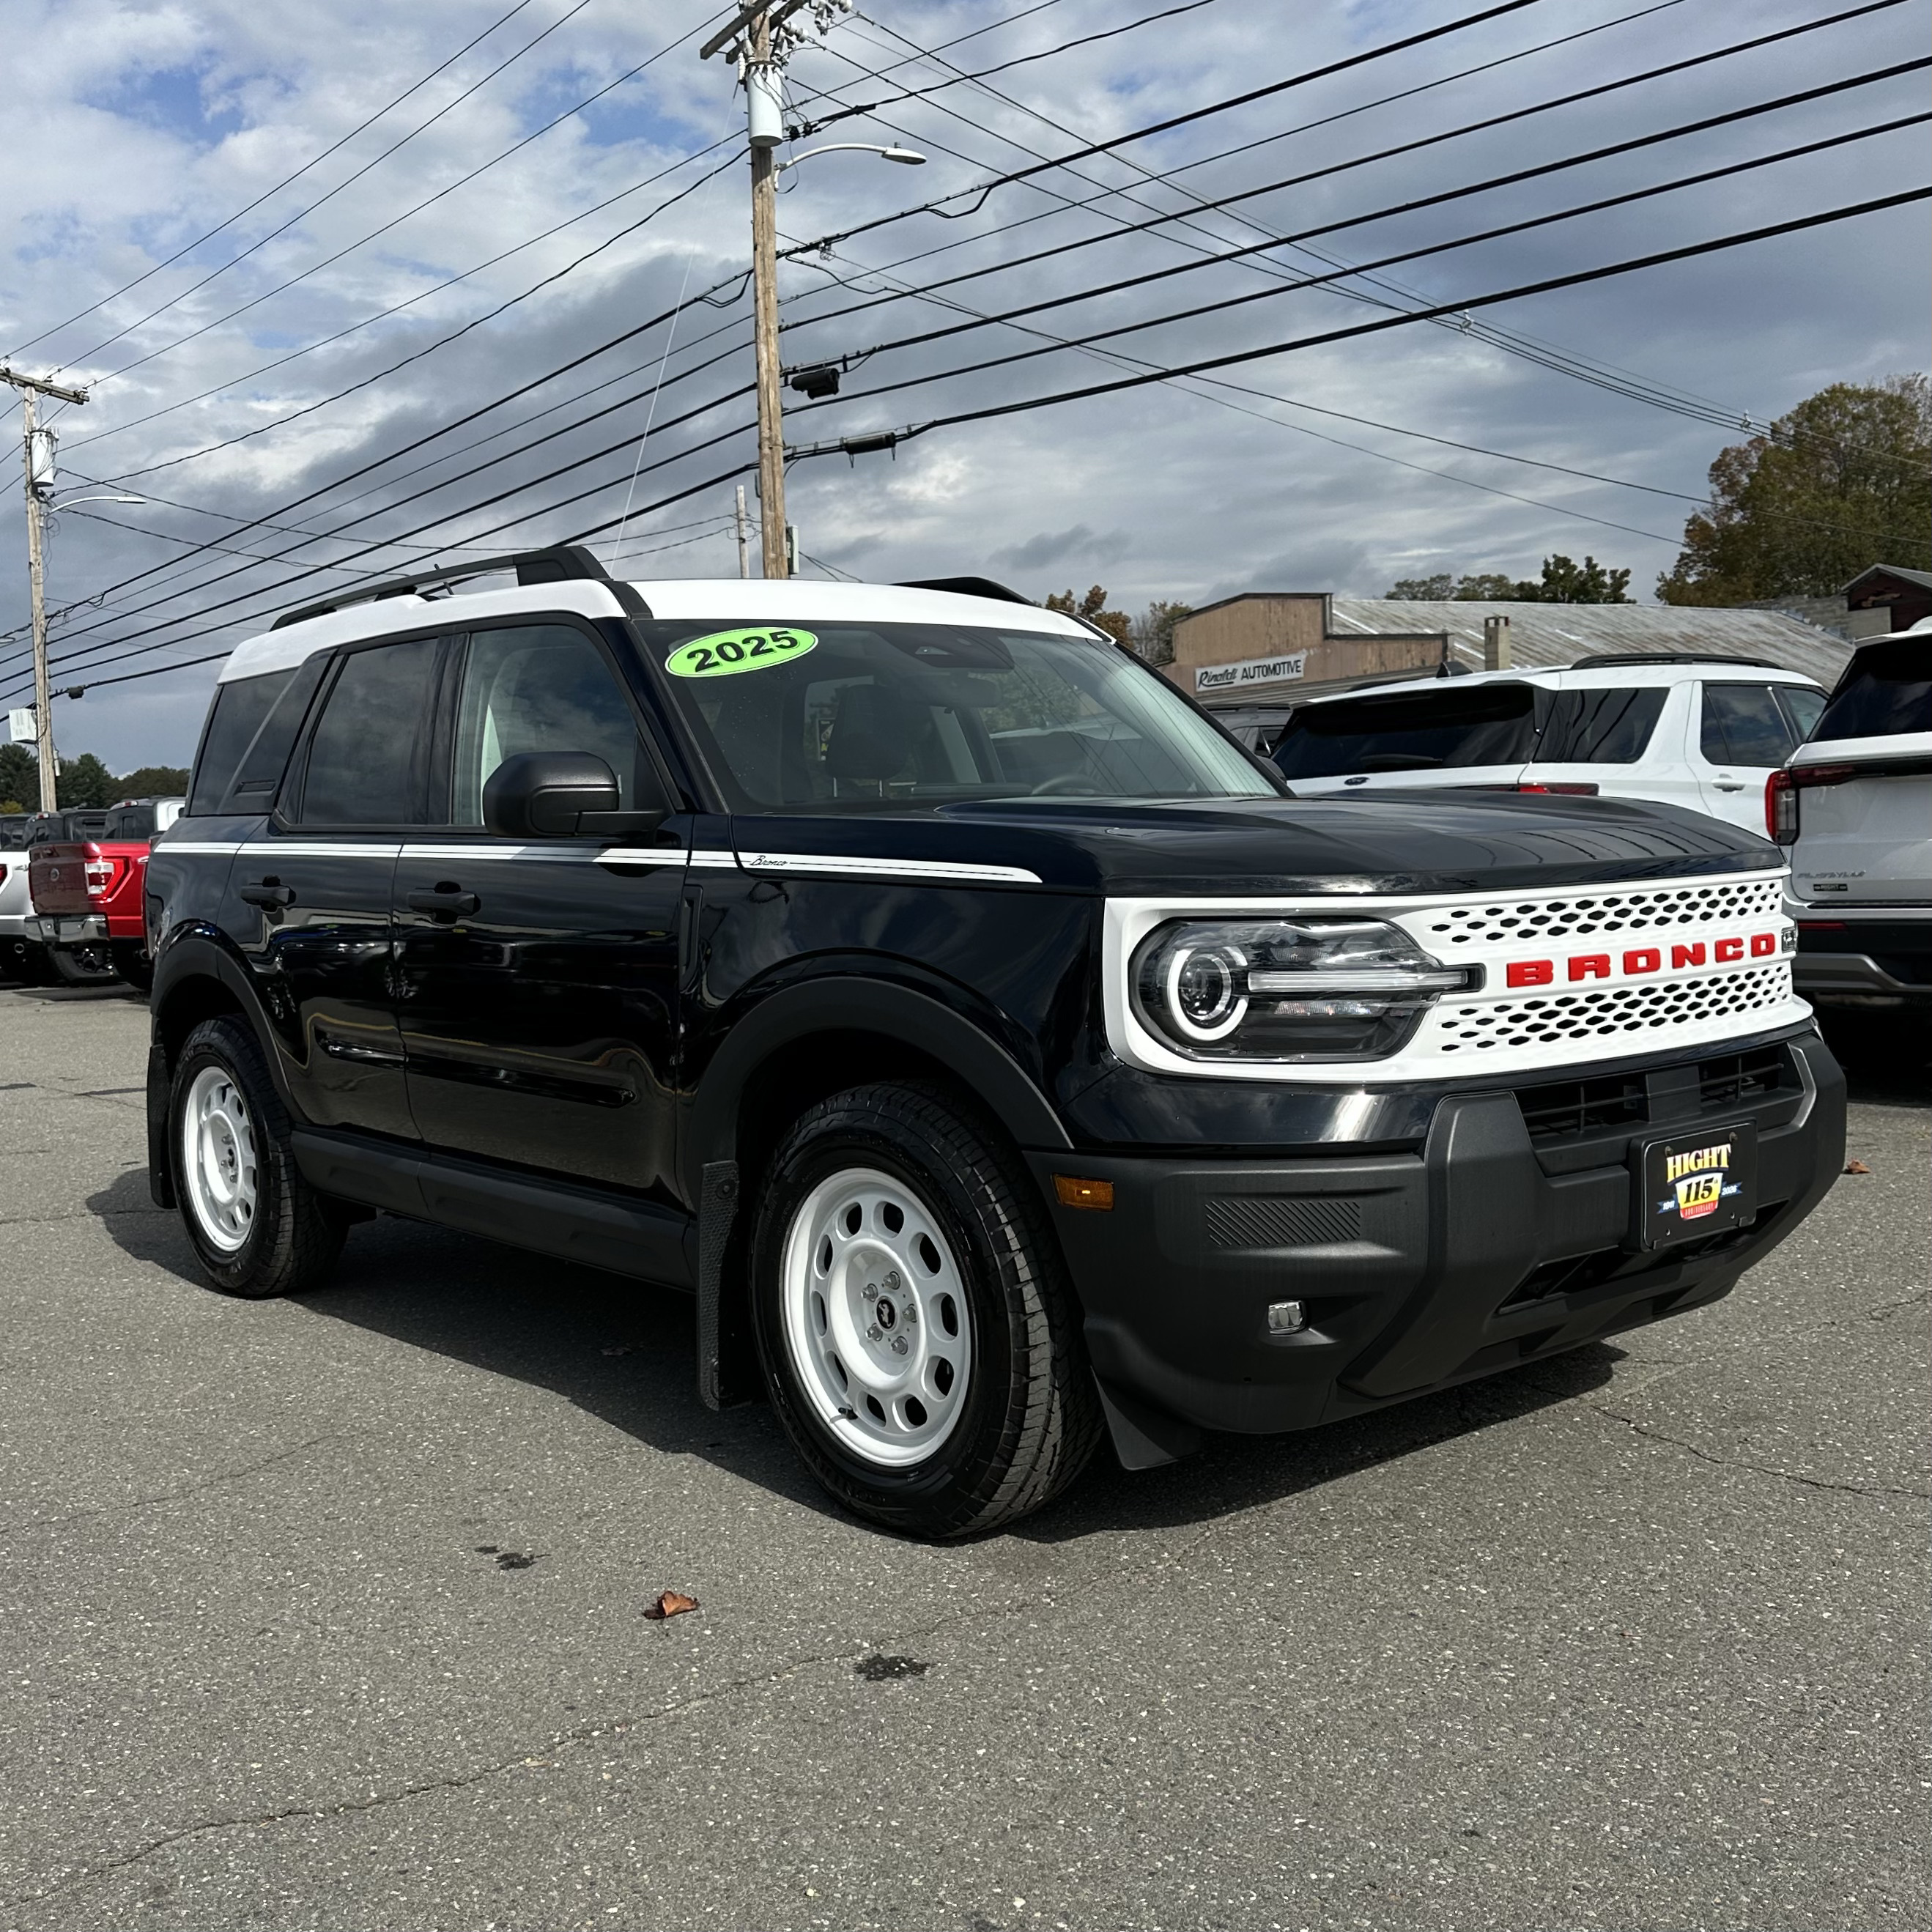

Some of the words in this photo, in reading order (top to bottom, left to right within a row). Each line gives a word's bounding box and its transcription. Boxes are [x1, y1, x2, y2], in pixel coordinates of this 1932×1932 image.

[686, 630, 799, 673] 2025
[1198, 667, 1238, 688] Rinaldi
[1240, 659, 1302, 680] AUTOMOTIVE
[750, 854, 788, 866] Bronco
[1506, 932, 1775, 988] BRONCO
[1666, 1143, 1732, 1183] HIGHT
